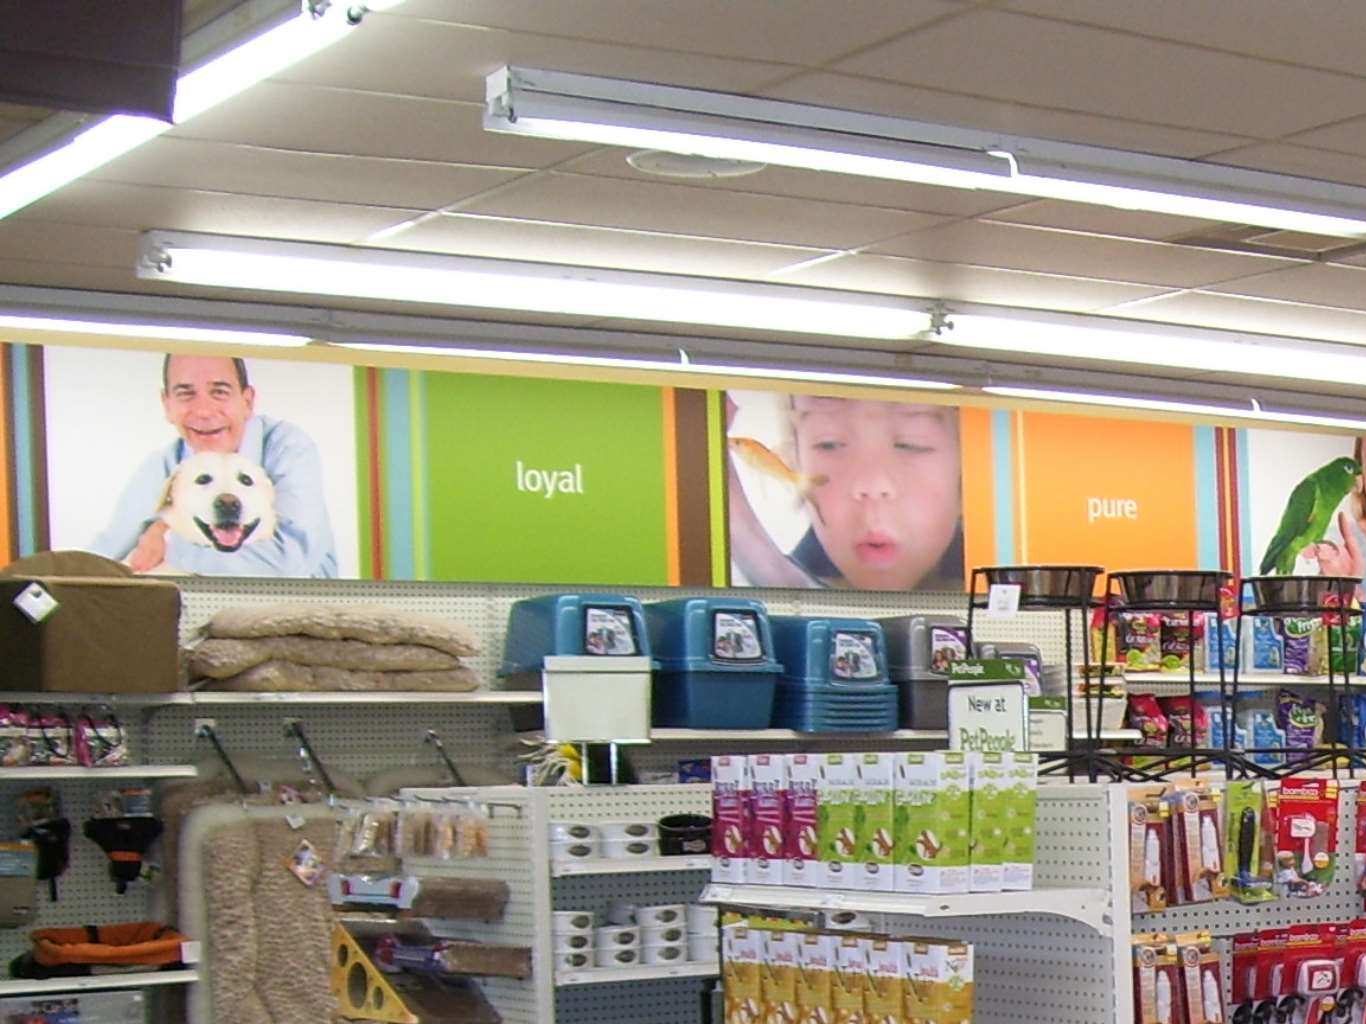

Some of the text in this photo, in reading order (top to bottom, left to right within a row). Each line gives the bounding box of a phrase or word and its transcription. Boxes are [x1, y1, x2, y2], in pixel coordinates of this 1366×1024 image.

[516, 460, 583, 499] loyal
[1087, 497, 1137, 523] pure
[967, 695, 1007, 713] New at
